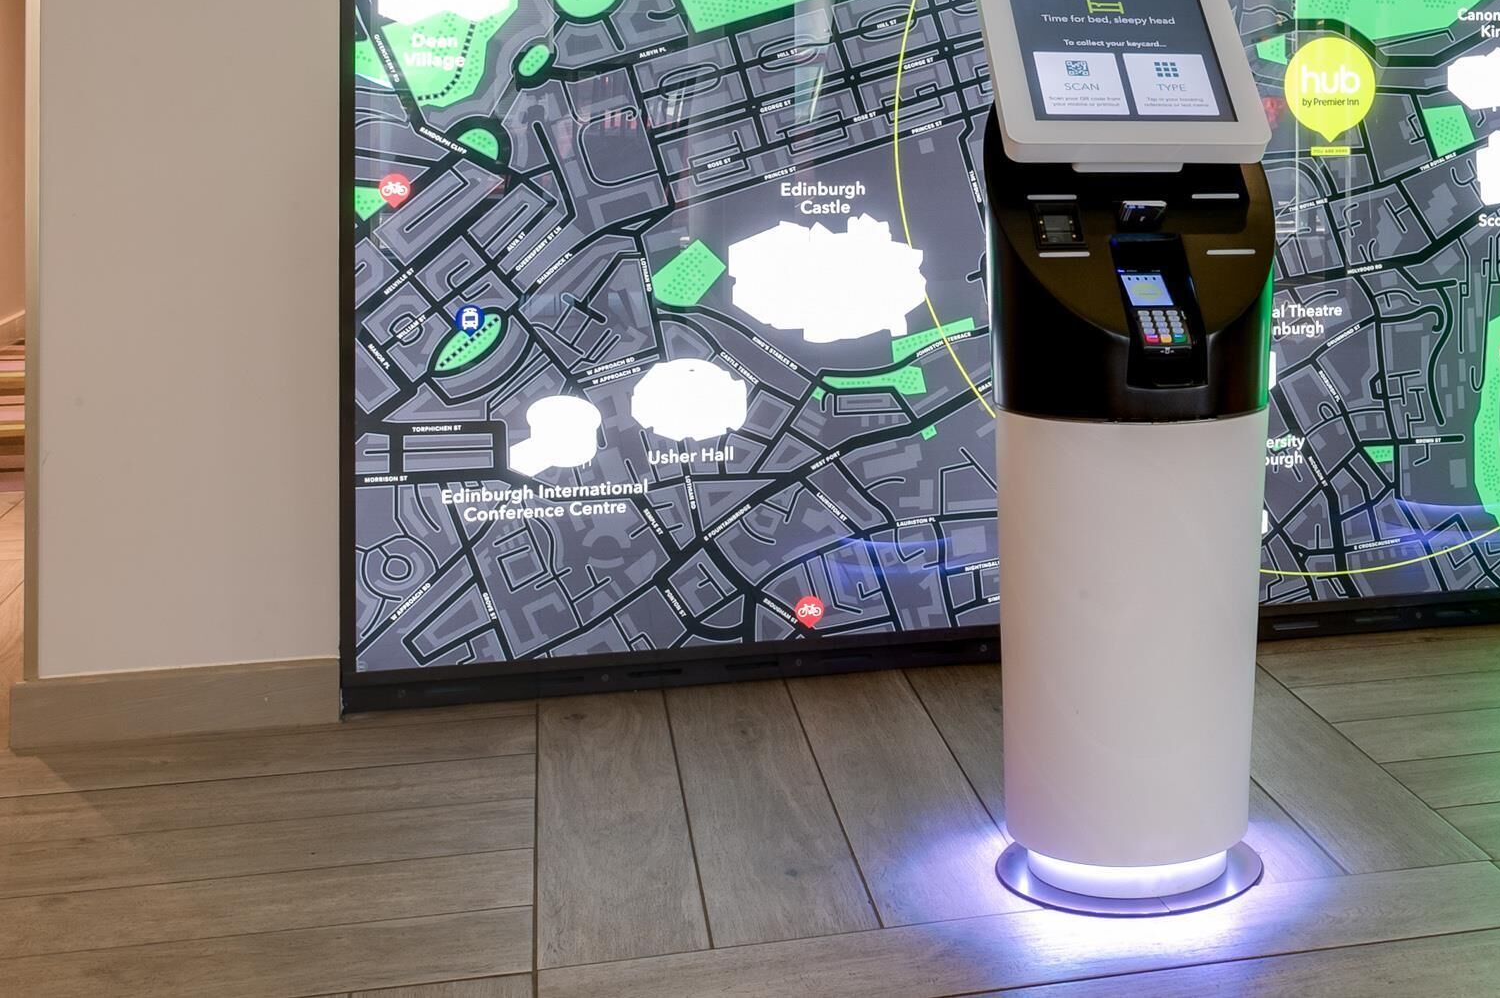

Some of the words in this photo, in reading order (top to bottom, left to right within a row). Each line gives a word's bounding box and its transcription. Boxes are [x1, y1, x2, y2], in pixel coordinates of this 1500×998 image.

[1088, 16, 1111, 24] bed,
[1114, 17, 1147, 25] sleepy
[411, 34, 458, 48] Dean
[404, 53, 465, 70] Village
[1065, 83, 1100, 91] SCAN
[1302, 65, 1360, 94] hub
[760, 103, 782, 113] GEORGE
[1302, 98, 1312, 107] by
[1314, 98, 1344, 107] Premier
[1347, 98, 1359, 106] Inn
[419, 126, 450, 148] RANDOLPH
[450, 141, 467, 154] CLIFF
[764, 169, 787, 180] PRINCES
[781, 181, 866, 200] Edinburgh
[800, 201, 850, 214] Castle
[507, 236, 520, 252] ALVA
[517, 231, 526, 240] ST
[537, 257, 566, 284] SHANDWICK
[564, 252, 572, 261] PL
[640, 258, 650, 282] LOTHIAN
[646, 282, 652, 292] RD
[384, 274, 406, 295] MELVILLE
[406, 268, 414, 276] ST
[1288, 305, 1342, 318] Theatre
[396, 321, 418, 339] WILLIAM
[417, 314, 426, 323] ST
[1273, 321, 1324, 338] nburgh
[752, 336, 772, 351] KING'S
[768, 348, 790, 365] STABLES
[788, 362, 797, 370] RD
[916, 339, 944, 358] JOHNSTON
[947, 332, 971, 344] TERRACE
[368, 343, 386, 363] MANOR
[382, 361, 390, 370] PL
[593, 360, 625, 373] APPROACH
[720, 352, 740, 366] CASTLE
[737, 365, 759, 384] TERRACE
[1266, 436, 1305, 450] ersity
[648, 449, 696, 466] Usher
[702, 447, 734, 462] Hall
[811, 459, 825, 471] WEST
[824, 452, 840, 463] PORT
[441, 484, 534, 505] Edinburgh
[539, 479, 649, 498] International
[464, 502, 564, 522] Conference
[570, 502, 626, 516] Centre
[816, 492, 842, 517] LAURISTON
[839, 513, 847, 521] ST
[707, 505, 751, 538] FOUNTAINBRIDGE
[897, 518, 925, 527] LAURISTON
[396, 591, 422, 617] APPROACH
[421, 583, 431, 592] RD
